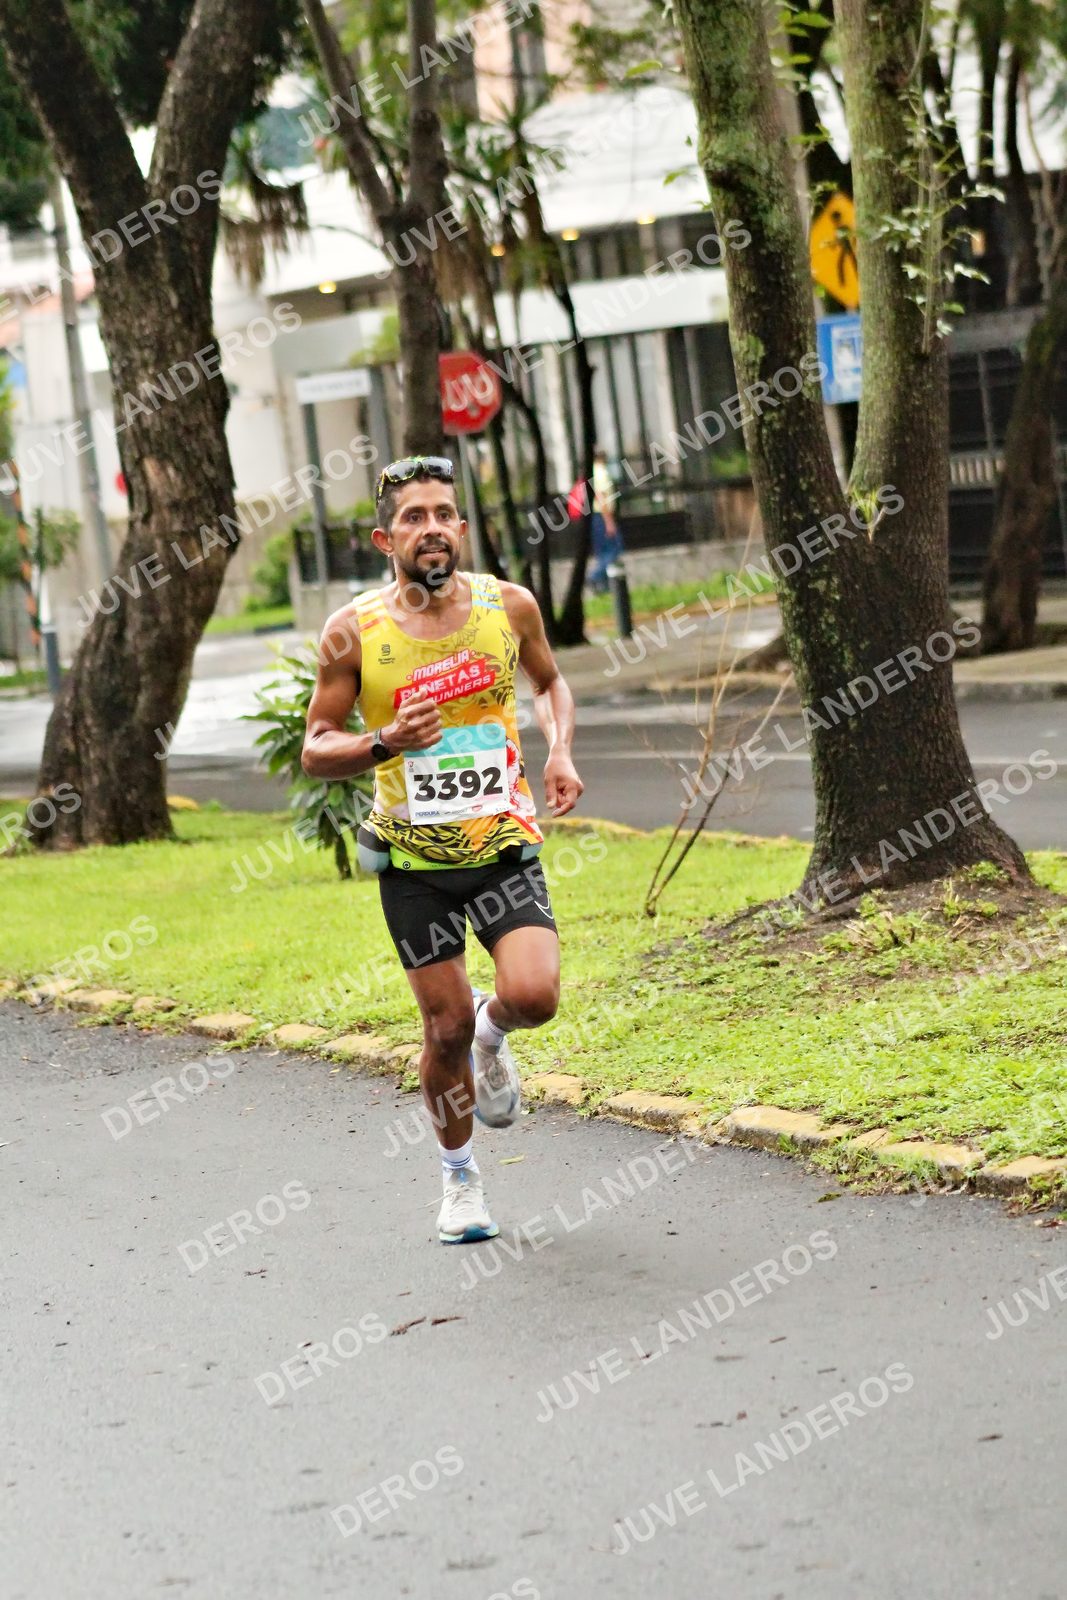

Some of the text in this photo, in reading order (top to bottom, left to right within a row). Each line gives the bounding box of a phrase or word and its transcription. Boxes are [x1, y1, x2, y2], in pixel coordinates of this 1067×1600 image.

[413, 648, 469, 681] MORELIA
[431, 674, 491, 703] UNNERS
[413, 767, 503, 802] 3392
